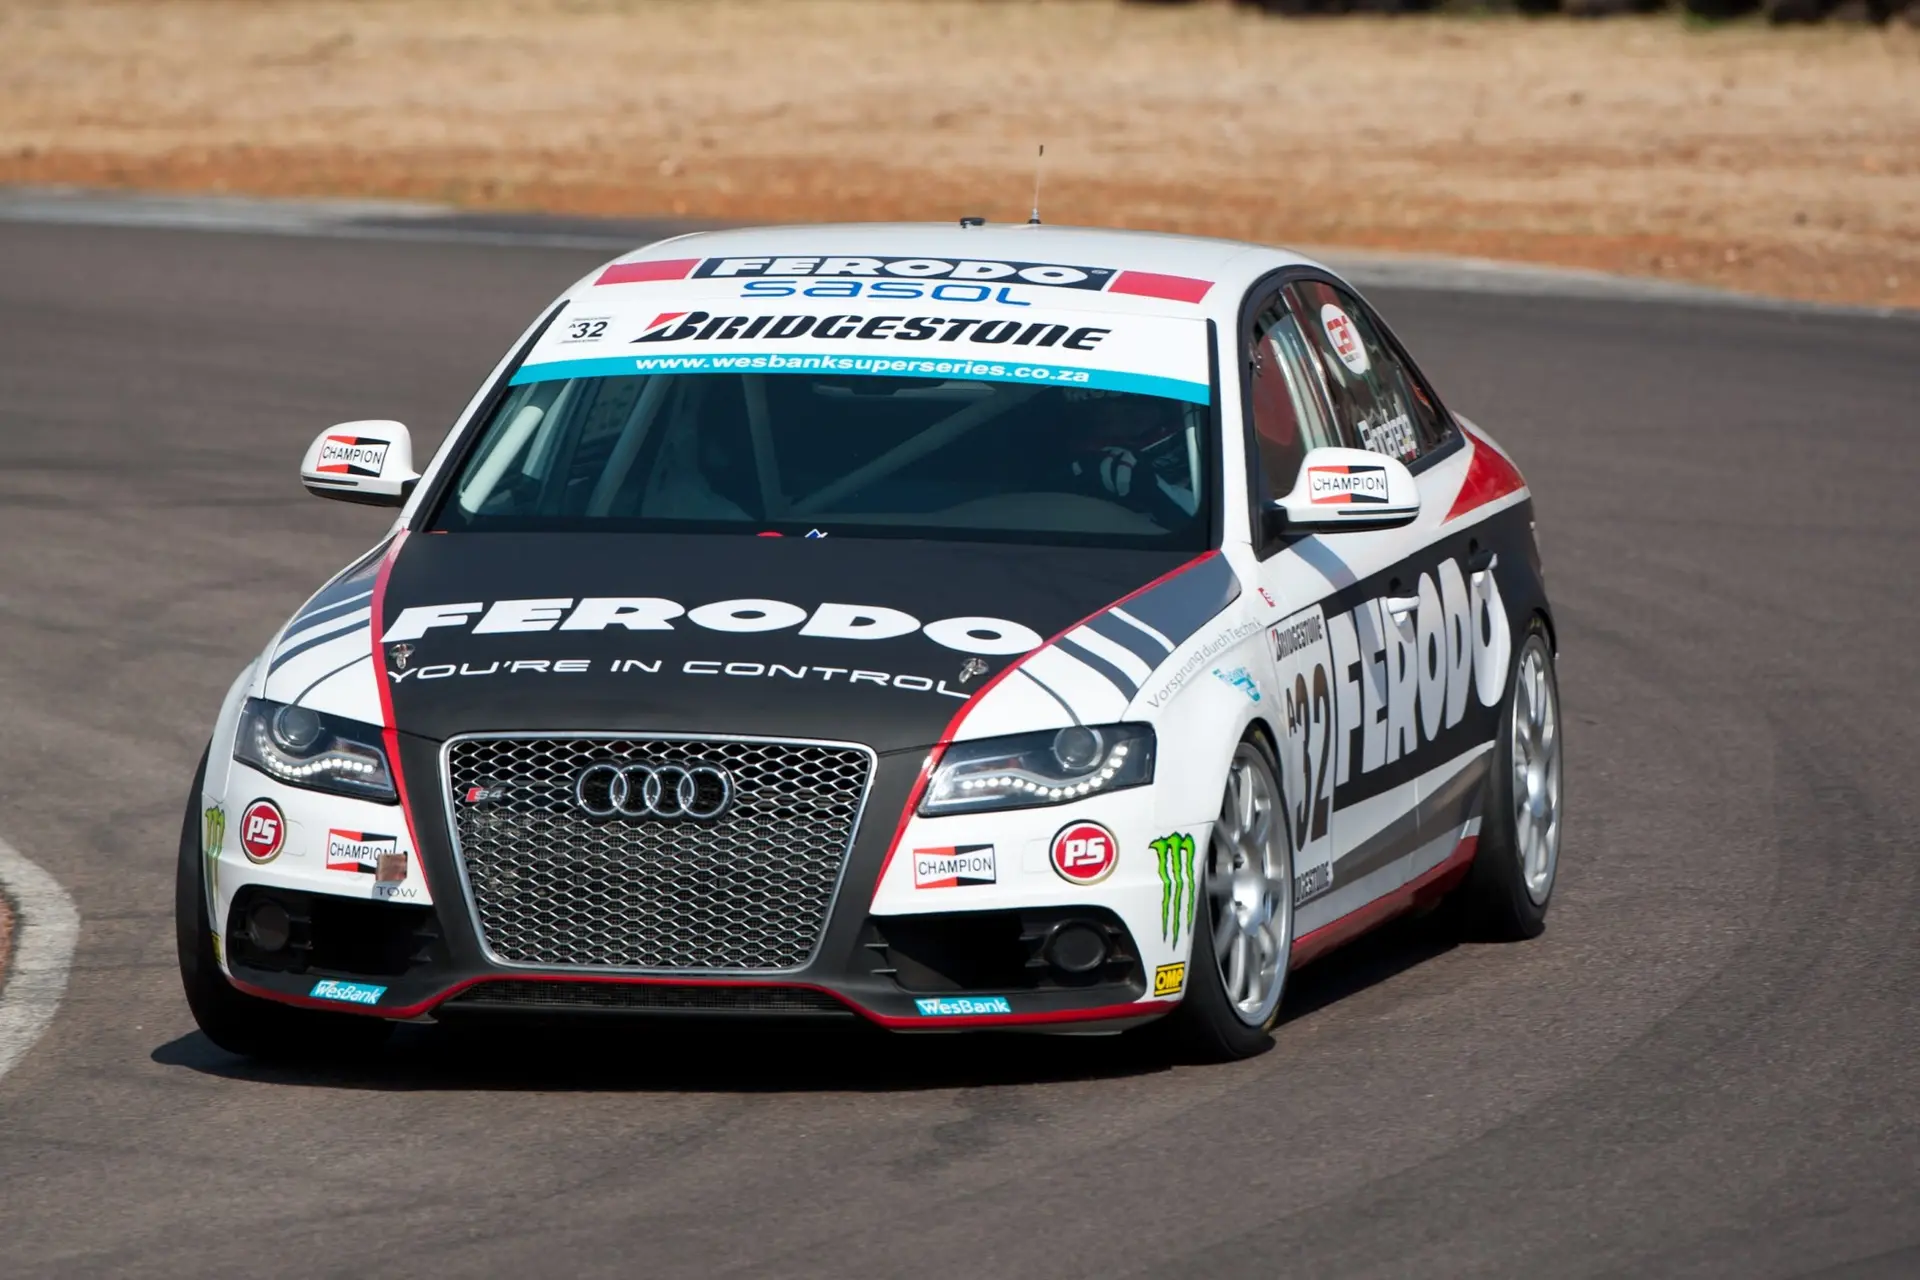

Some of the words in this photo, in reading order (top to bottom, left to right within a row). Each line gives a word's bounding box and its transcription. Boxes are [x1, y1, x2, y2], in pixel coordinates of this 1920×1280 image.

[710, 257, 1088, 285] FERODO
[628, 311, 1112, 351] BRIDGESTONE
[636, 355, 1090, 382] www.wesbanksuperseries.co.za
[323, 446, 382, 464] CHAMPION
[1313, 477, 1385, 491] CHAMPION
[380, 598, 1044, 655] FERODO
[387, 659, 591, 683] YOU'RE
[610, 659, 662, 673] IN
[682, 661, 972, 699] CONTROL
[1147, 650, 1205, 708] Vorsprung
[1203, 632, 1229, 657] durch
[1327, 559, 1511, 787] FERODO
[246, 815, 277, 846] PS
[1064, 837, 1106, 868] PS
[918, 858, 992, 876] CHAMPION
[376, 885, 417, 898] TOW
[315, 980, 381, 1004] WesBank
[1156, 968, 1185, 990] OMP
[917, 999, 1012, 1014] WesBank
